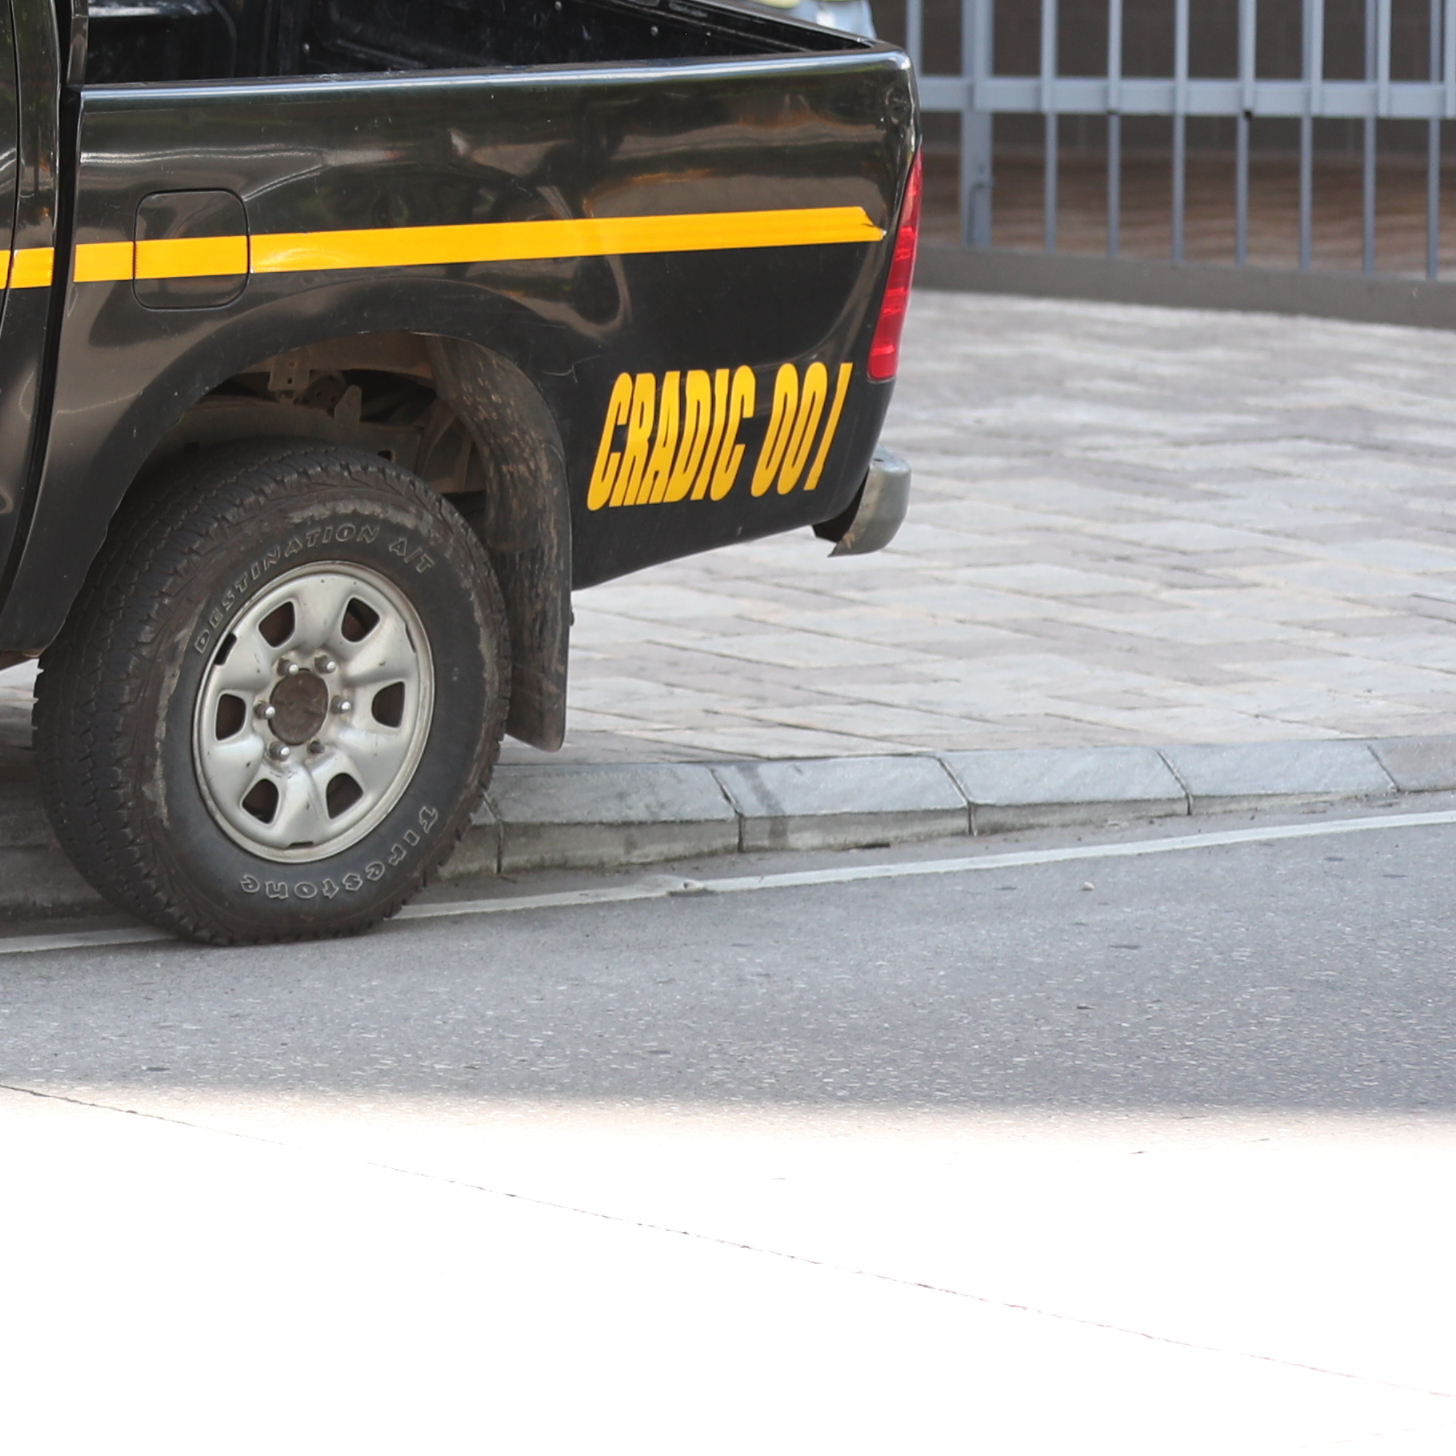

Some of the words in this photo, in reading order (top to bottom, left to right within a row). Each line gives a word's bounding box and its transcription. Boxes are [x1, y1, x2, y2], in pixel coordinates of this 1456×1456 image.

[586, 364, 756, 512] CRADIC
[750, 361, 854, 498] 001
[194, 523, 380, 655] DESTINATION
[388, 537, 435, 574] A/T
[240, 805, 438, 900] Firestone
